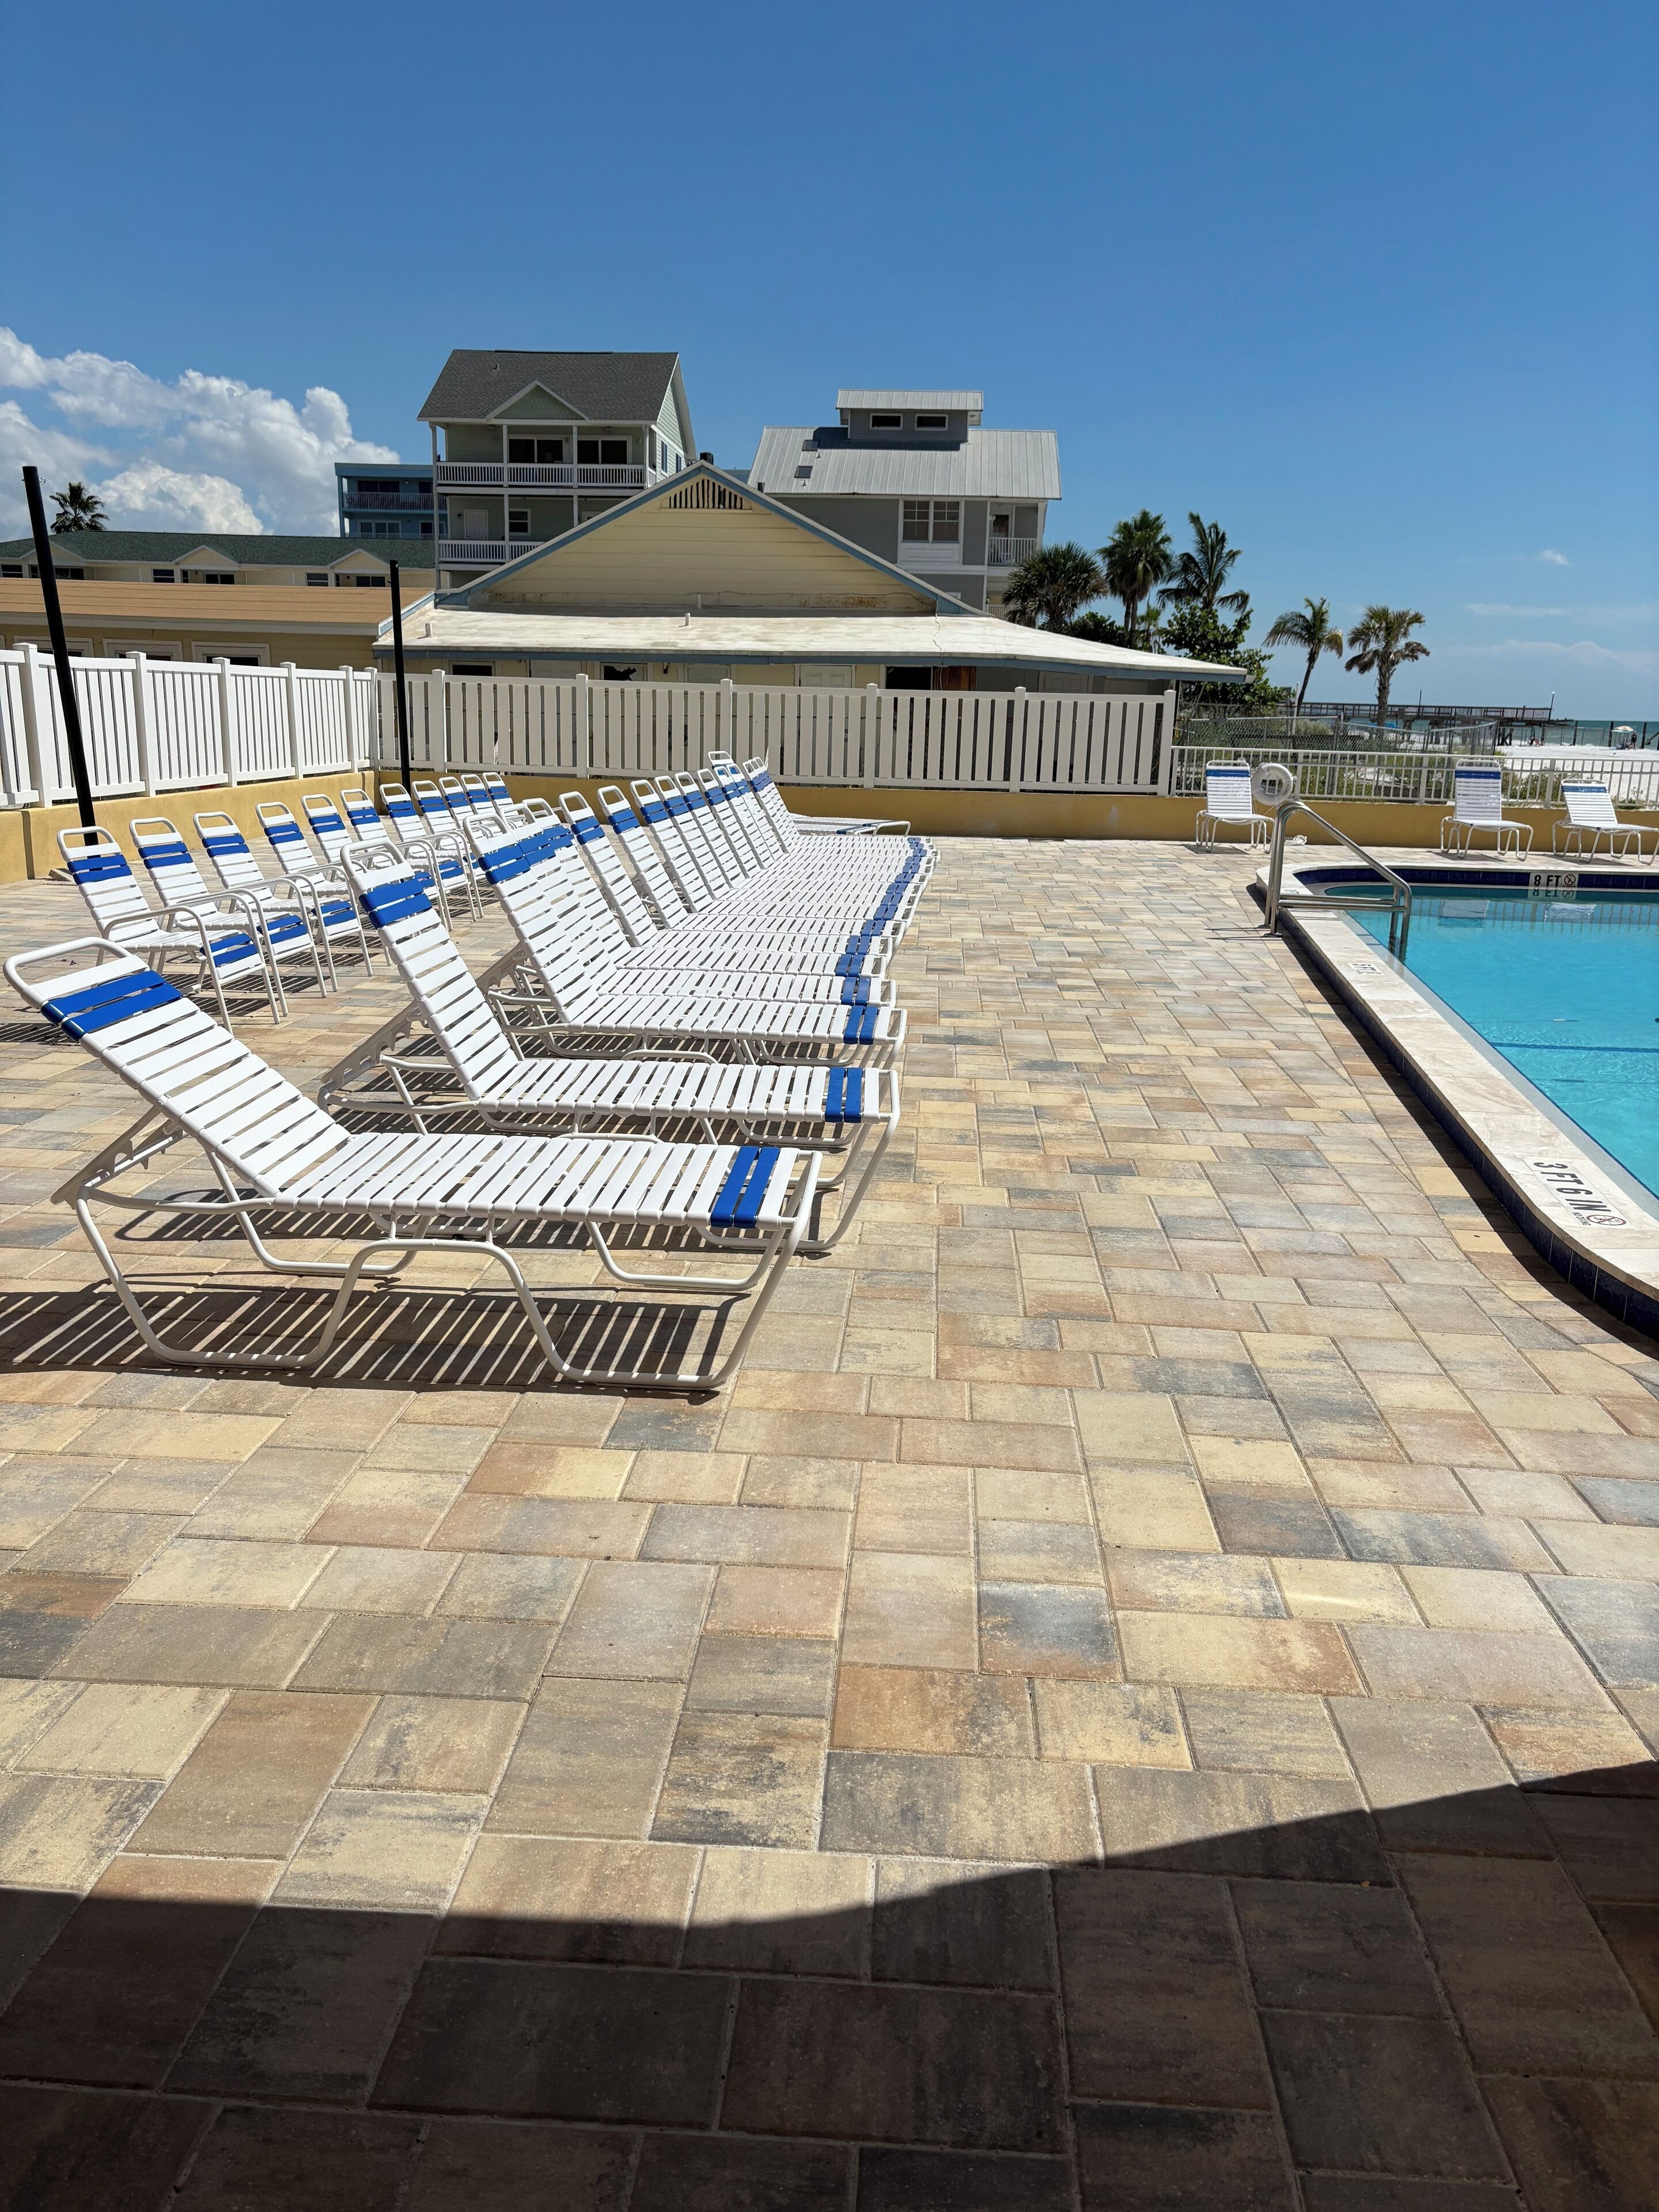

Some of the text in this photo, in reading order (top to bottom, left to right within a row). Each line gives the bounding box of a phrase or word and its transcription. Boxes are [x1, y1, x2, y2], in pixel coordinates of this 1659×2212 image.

[1533, 874, 1562, 887] 8 FT
[1540, 1172, 1585, 1185] FT
[1565, 1199, 1612, 1212] IN
